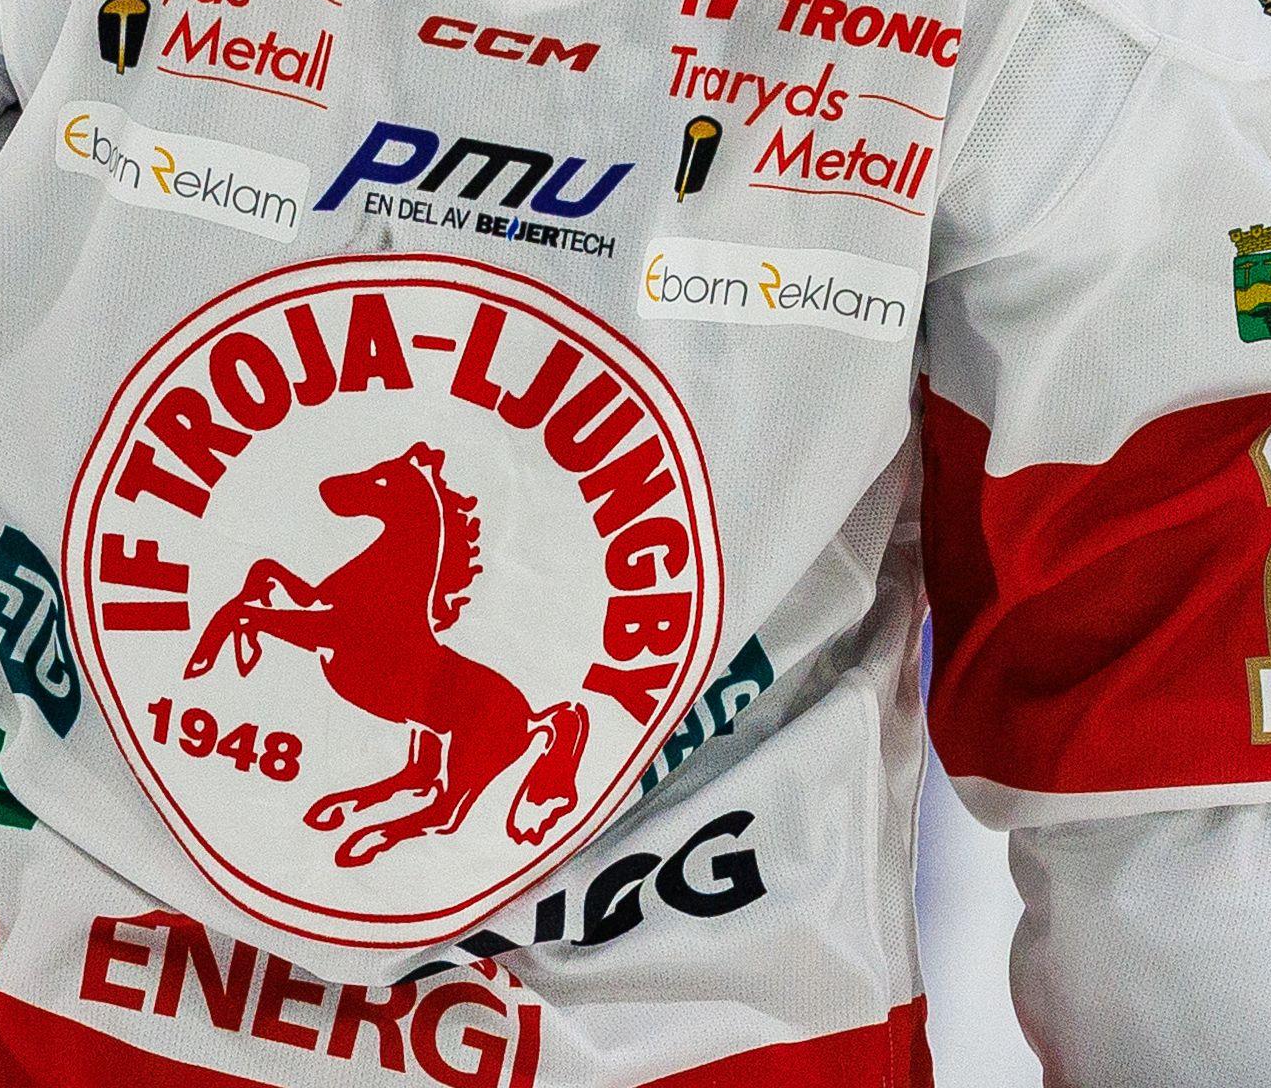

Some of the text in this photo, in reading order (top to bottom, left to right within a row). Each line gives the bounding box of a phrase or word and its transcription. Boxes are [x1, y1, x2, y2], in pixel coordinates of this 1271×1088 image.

[160, 11, 334, 91] Metall
[418, 15, 601, 72] CCM
[669, 45, 849, 126] Traryds
[753, 127, 934, 200] Metall
[364, 192, 394, 216] EN
[398, 198, 438, 226] DEL
[441, 207, 472, 230] AV
[123, 294, 700, 727] TROJA-LJUNGBY
[101, 533, 191, 632] IF
[145, 697, 303, 782] 1948
[78, 910, 542, 1088] ENERGI
